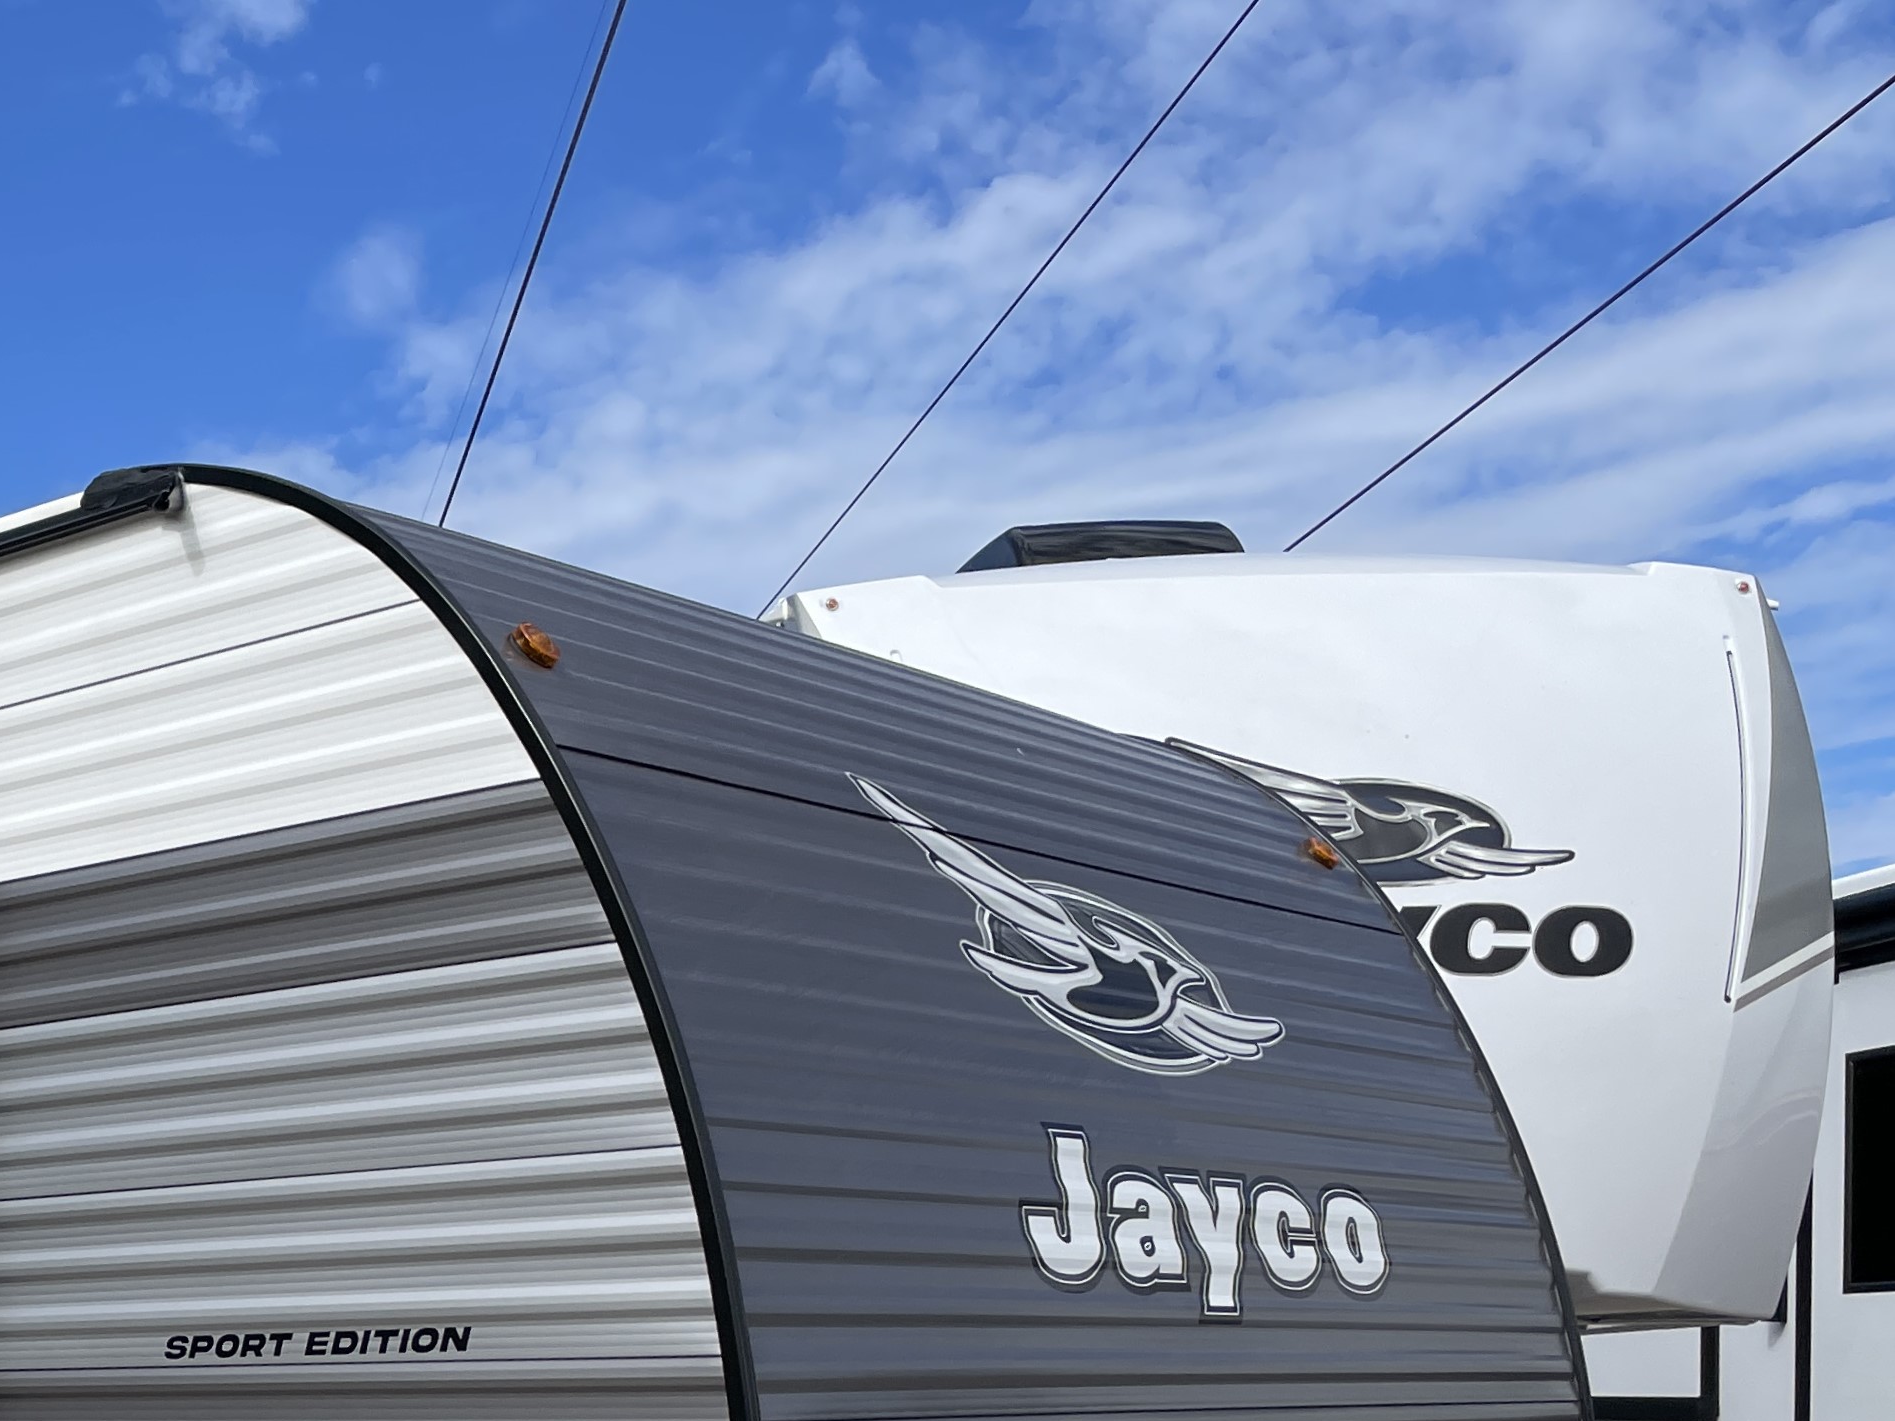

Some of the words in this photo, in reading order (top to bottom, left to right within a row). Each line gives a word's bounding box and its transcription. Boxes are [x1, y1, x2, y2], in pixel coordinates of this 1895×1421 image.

[1021, 1127, 1390, 1318] Jayco
[164, 1332, 294, 1360] SPORT
[304, 1326, 472, 1356] EDITION
